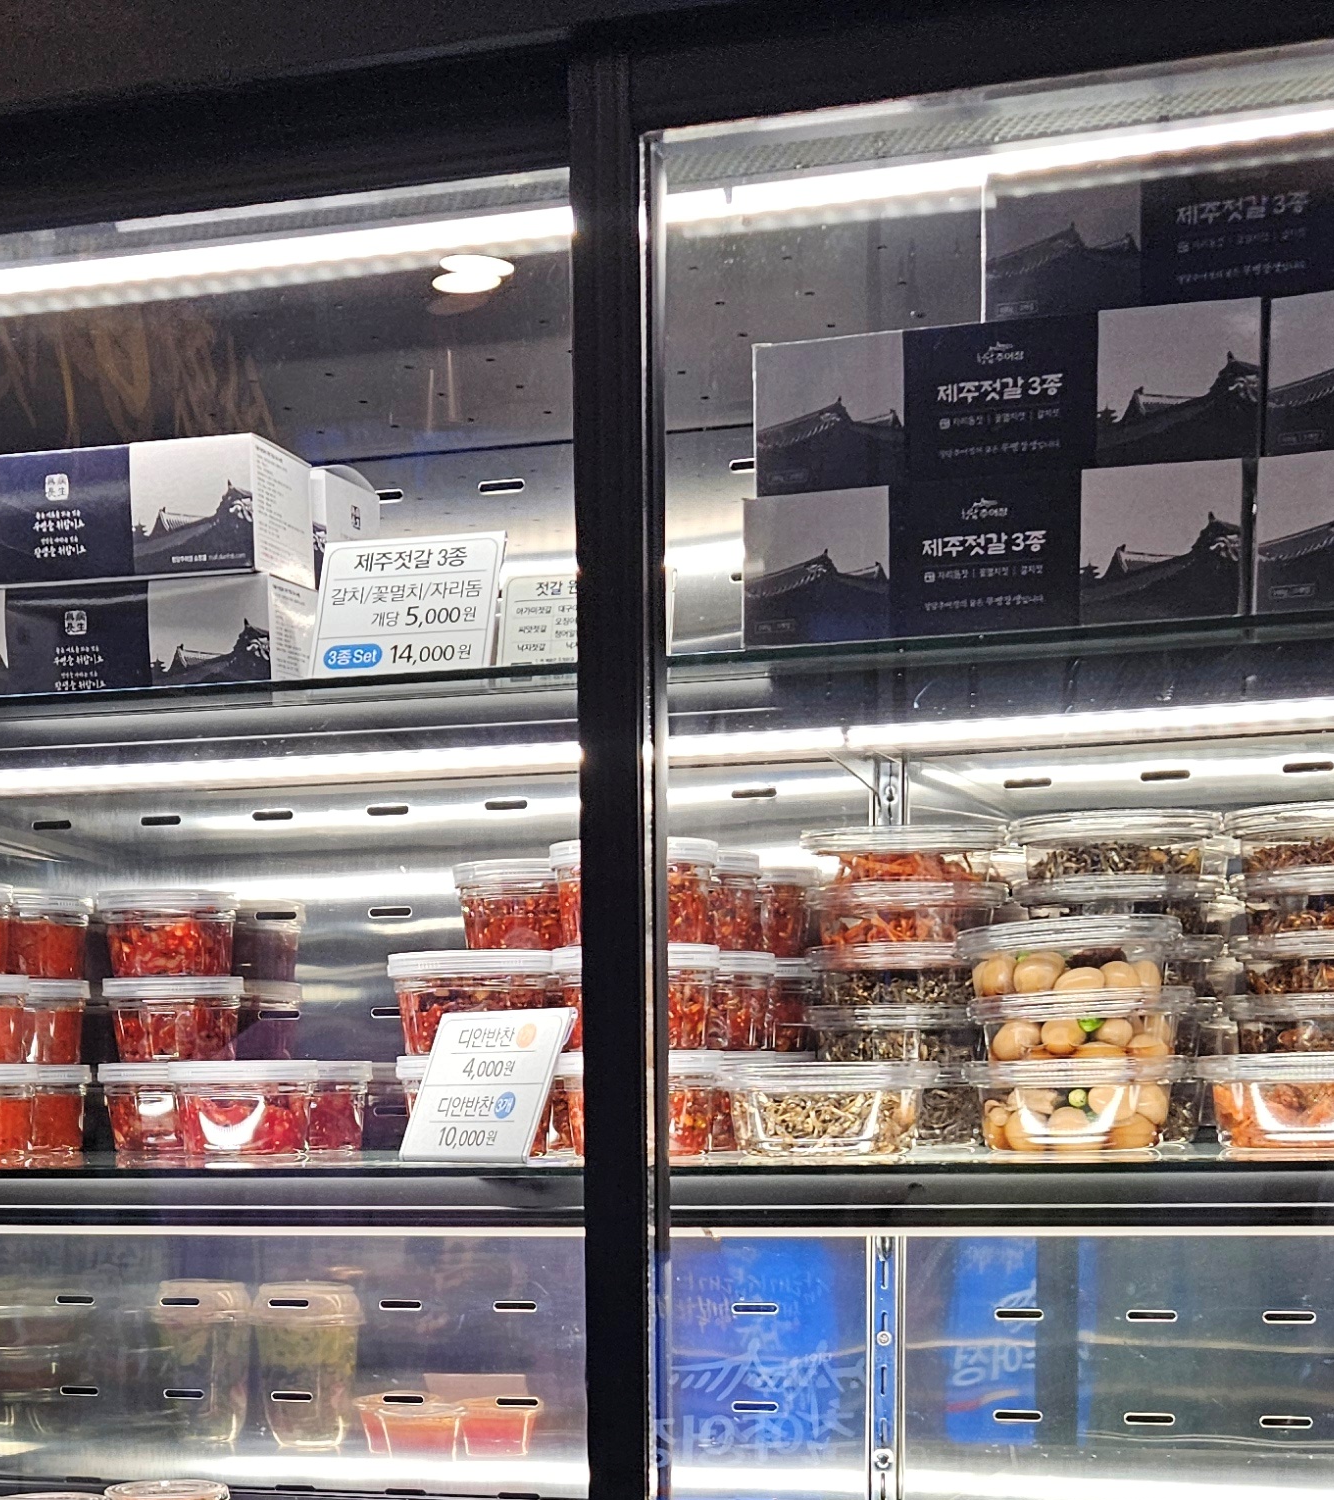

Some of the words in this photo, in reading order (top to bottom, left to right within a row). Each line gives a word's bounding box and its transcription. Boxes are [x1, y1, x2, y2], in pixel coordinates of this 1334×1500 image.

[937, 376, 1025, 403] 제주젓갈
[1028, 373, 1064, 396] 3종
[922, 532, 1009, 558] 제주젓갈
[1011, 530, 1047, 552] 3종
[353, 551, 432, 572] 제주젓갈
[437, 547, 468, 567] 3종
[331, 578, 483, 606] 갈치/꽃멸치/자리돔
[536, 580, 563, 597] 젓갈
[371, 611, 400, 627] 개당
[405, 606, 477, 628] 5,000원
[389, 644, 472, 666] 14,000원
[458, 1027, 515, 1049] 디안반찬
[462, 1057, 516, 1080] 4,000원
[437, 1096, 494, 1118] 디안반찬
[438, 1126, 498, 1149] 10,000원
